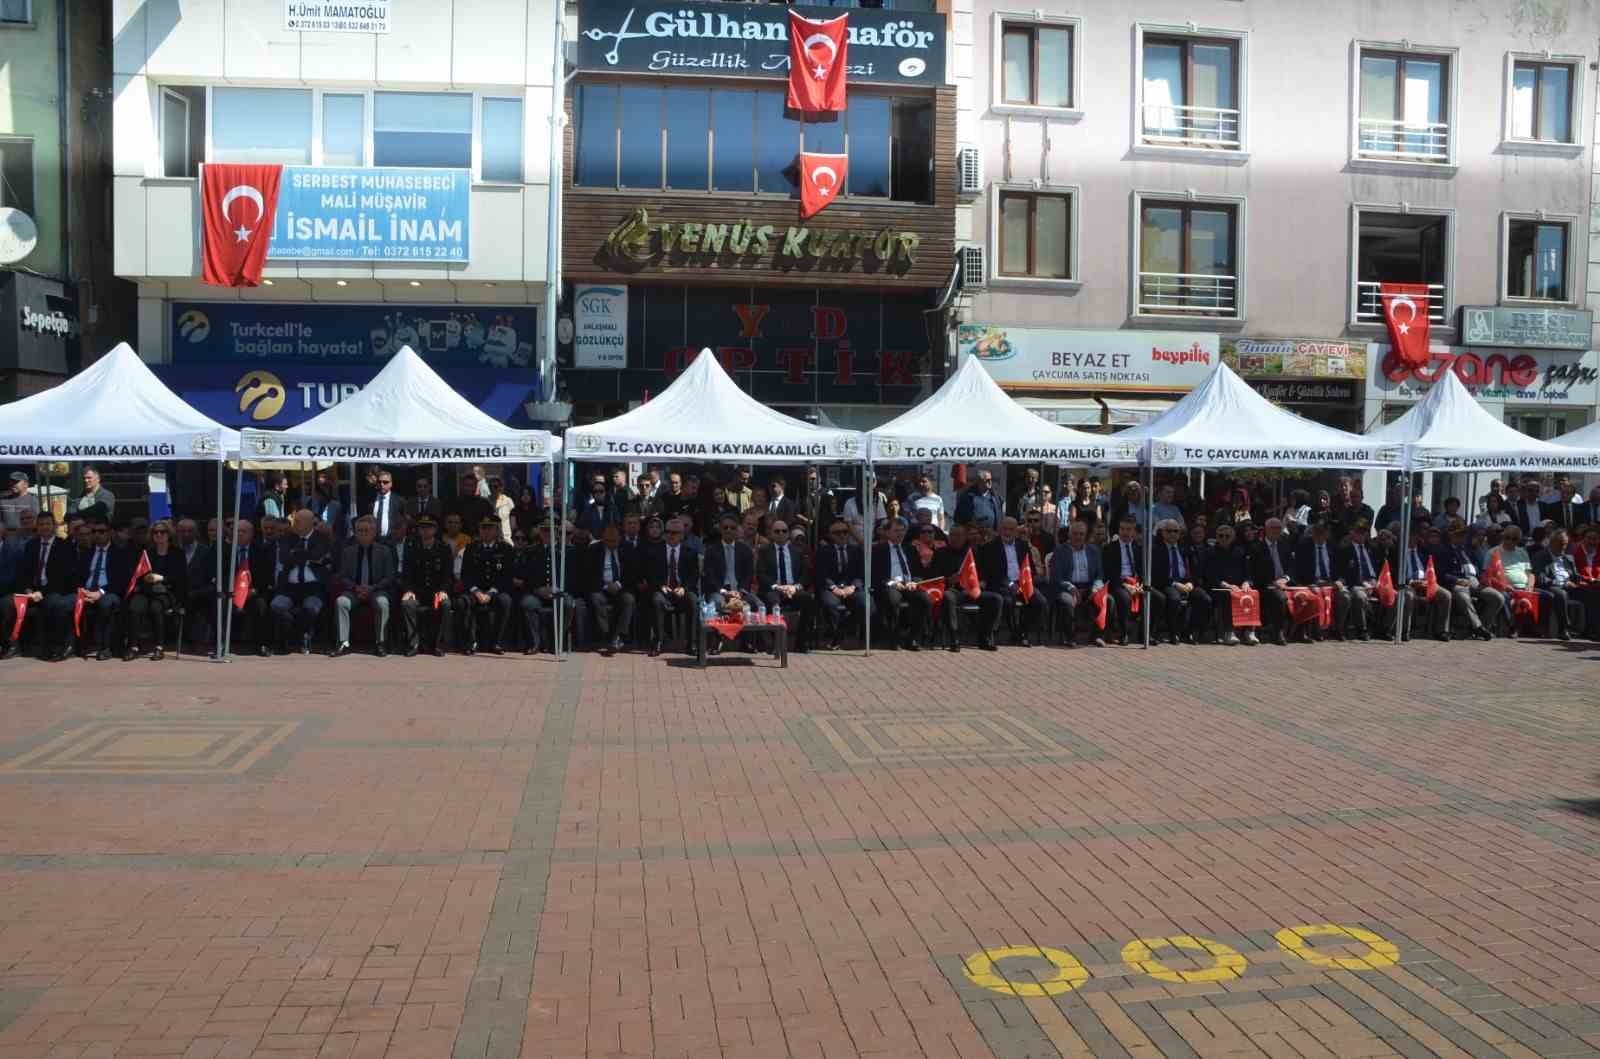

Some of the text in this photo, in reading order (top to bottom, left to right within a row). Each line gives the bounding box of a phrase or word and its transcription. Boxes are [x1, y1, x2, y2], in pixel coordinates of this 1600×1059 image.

[289, 2, 386, 19] H.Ümit MAMATOĞLU
[645, 11, 788, 42] Gülhan
[648, 50, 749, 71] Güzellik
[293, 172, 456, 190] SERBEST MUHASEBECİ
[321, 192, 427, 212] MALİ MÜŞAVİR
[287, 212, 462, 242] İSMAİL İNAM
[660, 219, 774, 257] VENÜS
[362, 246, 380, 257] Tel:
[384, 247, 409, 257] 0372
[435, 247, 448, 258] 22
[229, 321, 313, 337] Turkcell'le
[235, 340, 363, 357] bağlan hayata!
[1052, 351, 1131, 368] BEYAZ ET
[1032, 369, 1150, 382] ÇAYCUMA SATIŞ NOKTASI
[1481, 388, 1511, 398] vitamin
[51, 442, 175, 456] KAYMAKAMLIĞI
[307, 445, 380, 460] ÇAYCUMA
[386, 444, 507, 458] KAYMAKAMLIĞI
[634, 443, 707, 456] ÇAYCUMA
[712, 442, 826, 456] KAYMAKAMLIĞI
[930, 446, 997, 460] ÇAYCUMA
[1001, 447, 1105, 459] KAYMAKAMLIĞI
[1207, 448, 1269, 461] ÇAYCUMA
[1273, 447, 1369, 460] KAYMAKAMLIĞI
